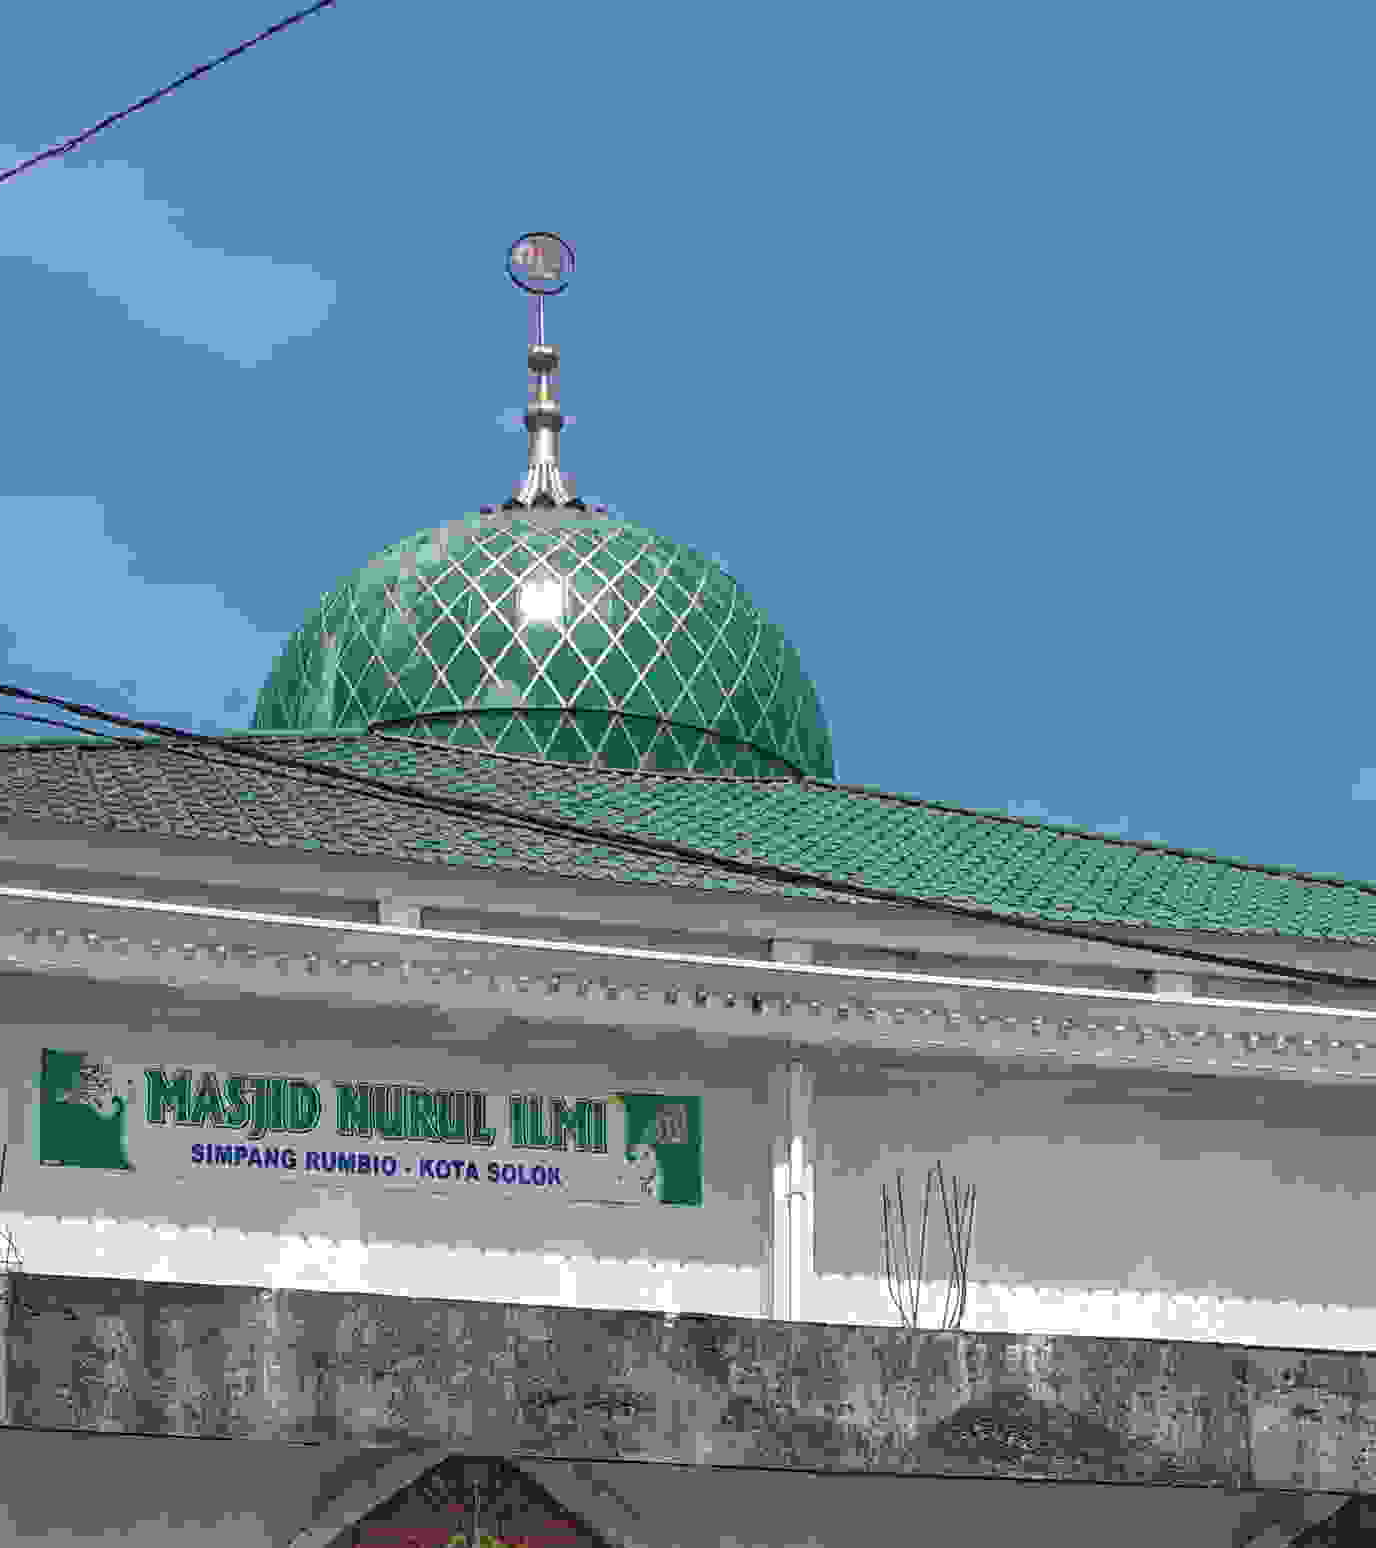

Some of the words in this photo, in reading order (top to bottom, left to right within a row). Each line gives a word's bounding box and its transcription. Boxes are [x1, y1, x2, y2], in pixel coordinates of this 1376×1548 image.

[142, 1067, 322, 1143] MASJID
[333, 1081, 497, 1149] NURUL
[510, 1092, 610, 1157] ILMI
[191, 1143, 297, 1170] SIMPANG
[304, 1151, 401, 1176] RUMBIO
[419, 1157, 481, 1184] KOTA
[487, 1160, 562, 1189] SOLOK
